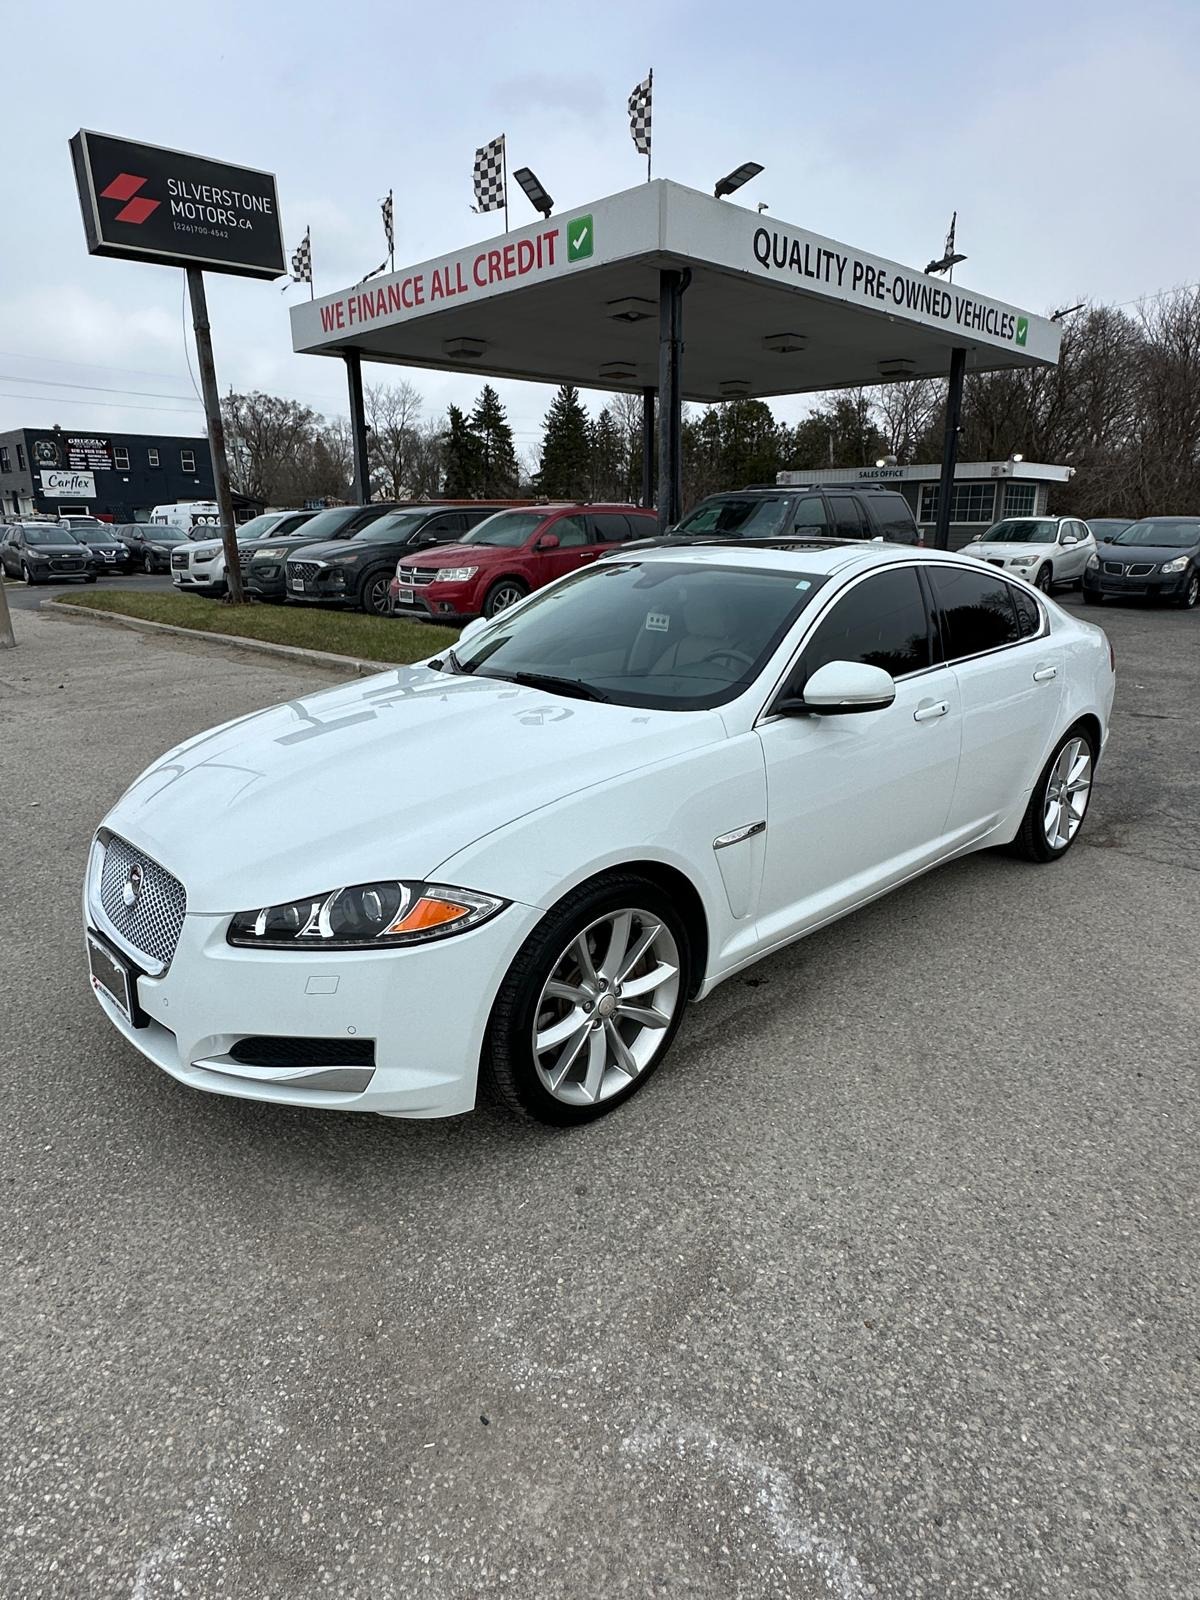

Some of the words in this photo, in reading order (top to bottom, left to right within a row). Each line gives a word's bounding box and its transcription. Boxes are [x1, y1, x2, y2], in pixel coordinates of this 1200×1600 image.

[167, 178, 273, 214] SILVERSTONE
[173, 221, 229, 239] (226)700-4542
[320, 301, 345, 332] WE
[348, 274, 425, 325] FINANCE
[430, 262, 468, 302] ALL
[473, 229, 559, 288] CREDIT
[753, 227, 848, 287] QUALITY
[852, 260, 951, 319] PRE-OWNED
[955, 296, 1015, 340] VEHICLES
[68, 438, 107, 446] GRIZZLY
[49, 474, 89, 490] Carflex
